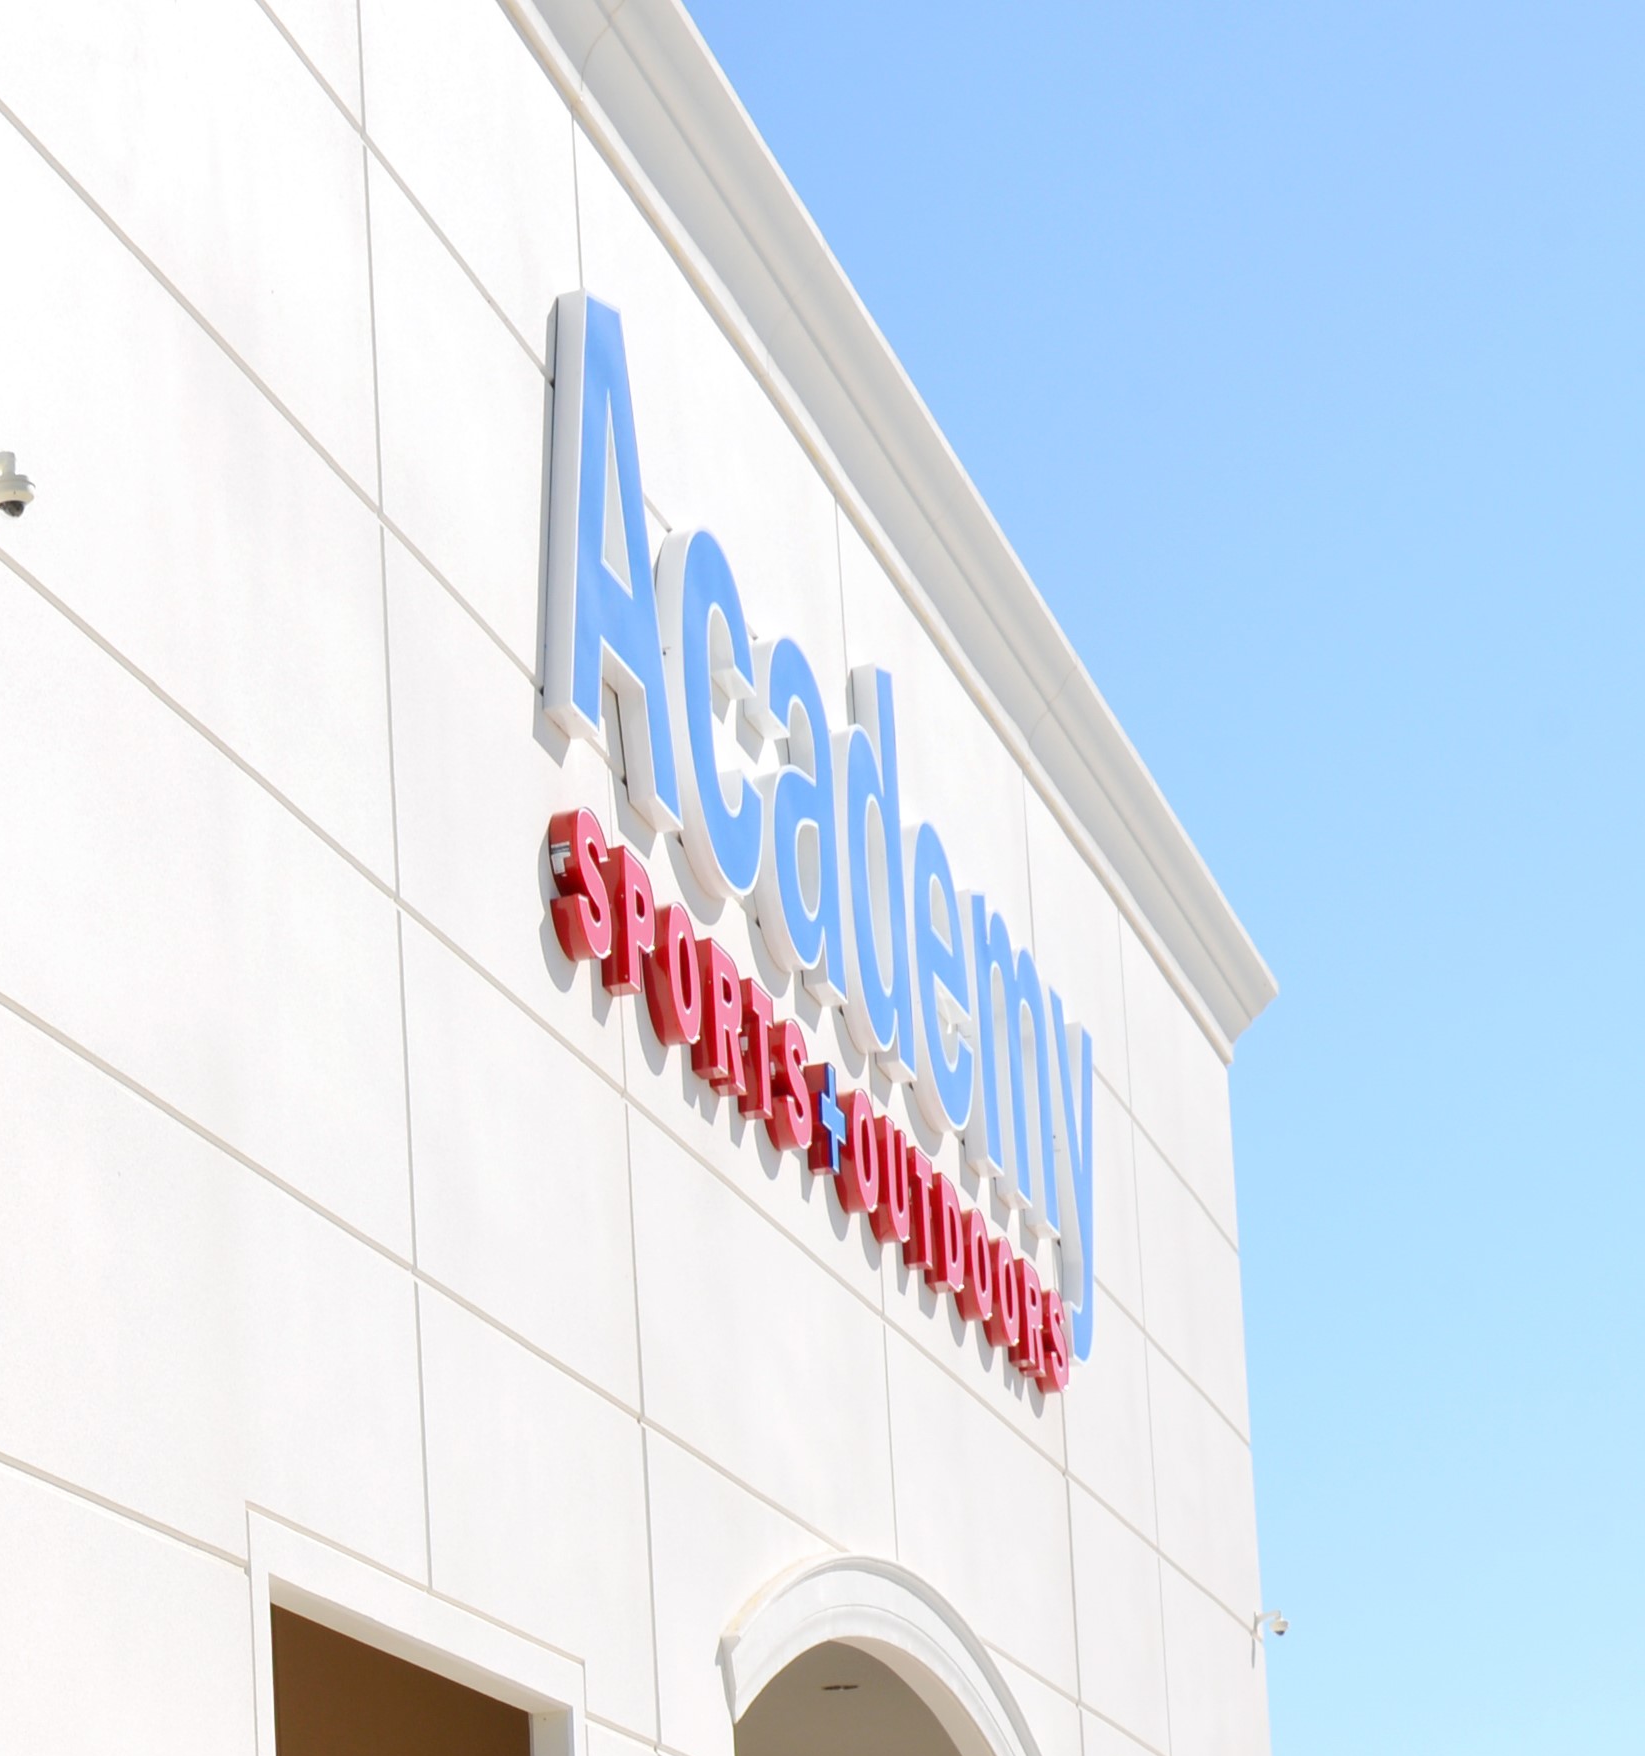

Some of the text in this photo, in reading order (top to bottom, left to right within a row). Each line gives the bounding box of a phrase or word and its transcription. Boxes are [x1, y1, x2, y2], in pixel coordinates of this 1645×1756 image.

[550, 806, 811, 1151] SPORTS
[836, 1088, 1070, 1393] OUTDOORS
[557, 288, 1094, 1364] Academy
